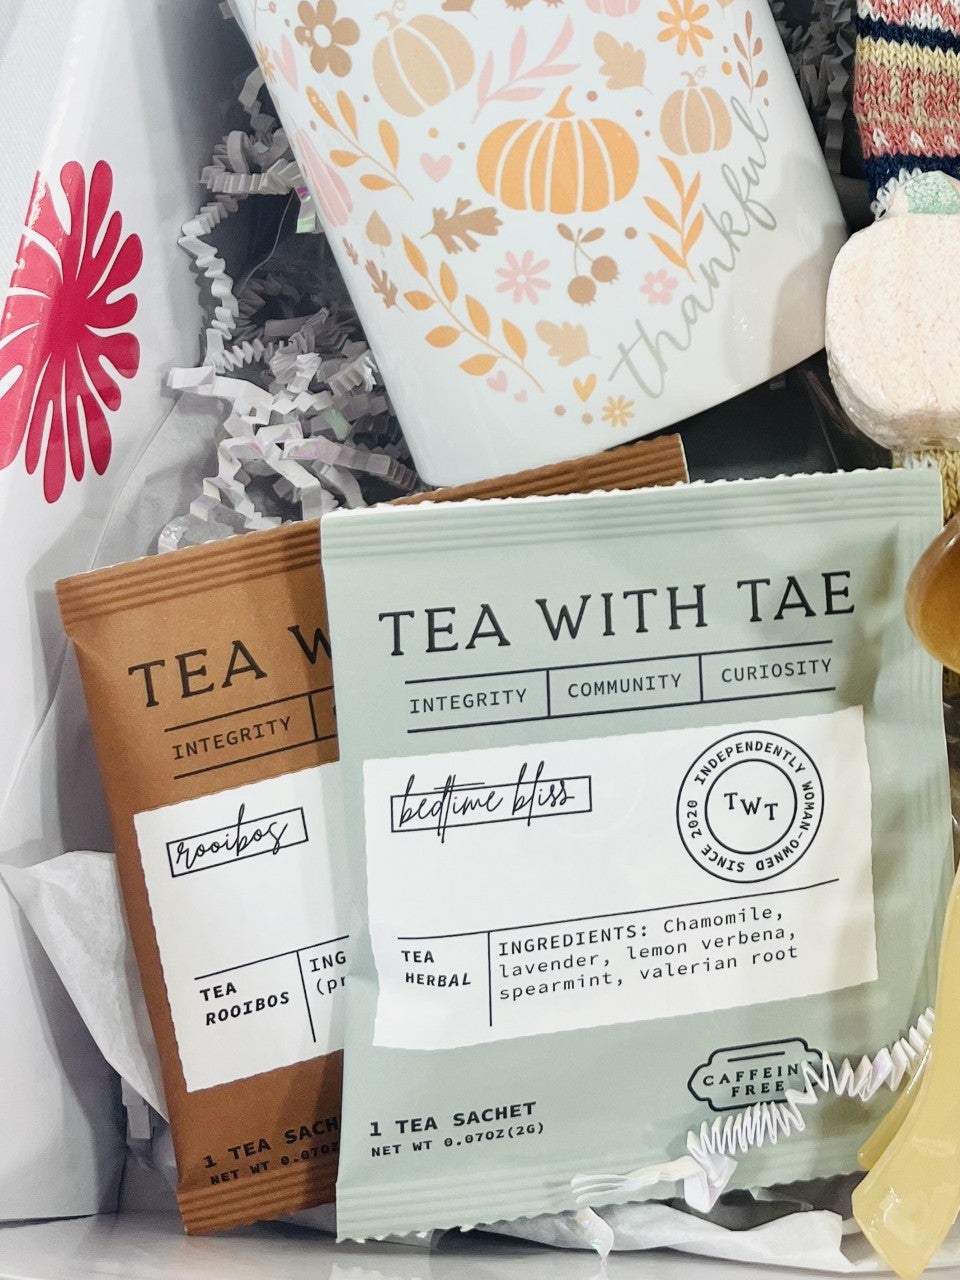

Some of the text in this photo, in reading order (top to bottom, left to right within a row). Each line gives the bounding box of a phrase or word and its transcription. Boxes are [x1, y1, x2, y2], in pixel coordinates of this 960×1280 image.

[608, 96, 777, 399] thankful
[378, 570, 856, 657] TEA WITH TAE
[128, 640, 268, 708] TEA
[568, 673, 682, 699] COMMUNITY
[721, 658, 832, 684] CURIOSITY
[409, 688, 527, 714] INTEGRITY
[173, 716, 291, 760] INTEGRITY
[694, 740, 806, 785] INDEPENDENTLY
[399, 760, 576, 843] bedtime bliss
[175, 803, 288, 869] rooibos
[687, 800, 703, 839] 2020
[700, 843, 745, 873] SINCE
[498, 907, 784, 957] INGREDIENTS: Chamomile,
[401, 950, 435, 964] TEA
[500, 926, 796, 979] lavender, lemon verbena,
[405, 971, 472, 987] HERBAL
[500, 945, 799, 1001] spearmint, valerian root
[200, 981, 237, 1002] TEA
[205, 991, 290, 1025] ROOIBOS
[703, 1061, 806, 1086] CAFFEIN
[731, 1080, 785, 1097] FREE
[369, 1101, 537, 1137] 1 TEA SACHET
[203, 1154, 217, 1169] 1
[228, 1138, 271, 1160] TEA
[371, 1144, 402, 1157] NET
[412, 1139, 433, 1152] WT
[210, 1169, 239, 1185] NET
[249, 1161, 269, 1174] WT
